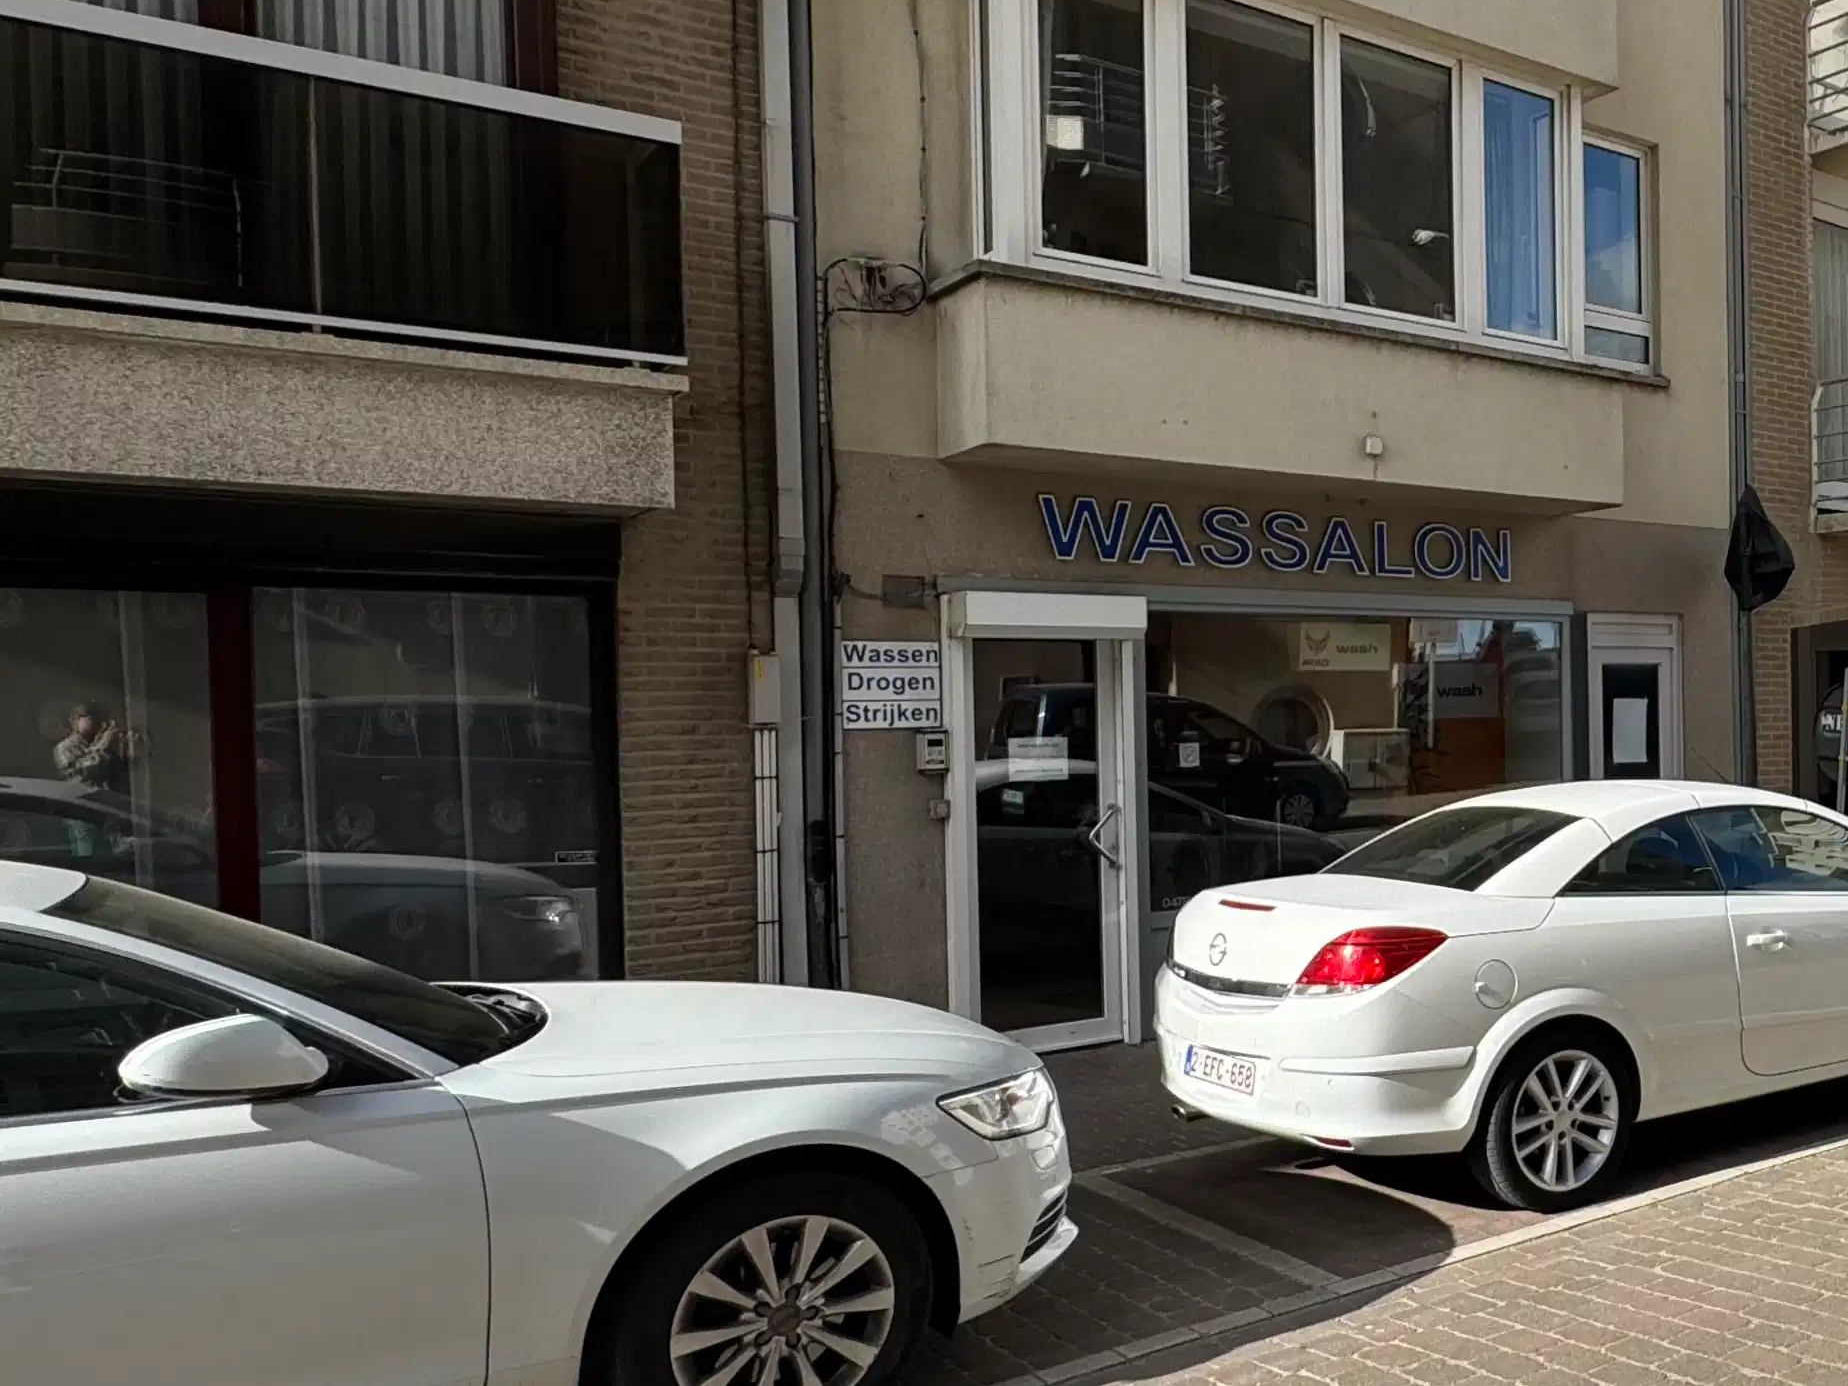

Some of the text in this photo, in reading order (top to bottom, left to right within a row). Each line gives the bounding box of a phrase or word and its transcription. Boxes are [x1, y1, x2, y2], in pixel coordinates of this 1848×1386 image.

[1037, 493, 1512, 583] WASSALON
[842, 643, 939, 664] Wassen
[846, 672, 936, 696] Drogen
[1436, 681, 1483, 699] wash
[845, 703, 939, 727] Strijken
[1191, 1051, 1253, 1089] 2-EFC-658
